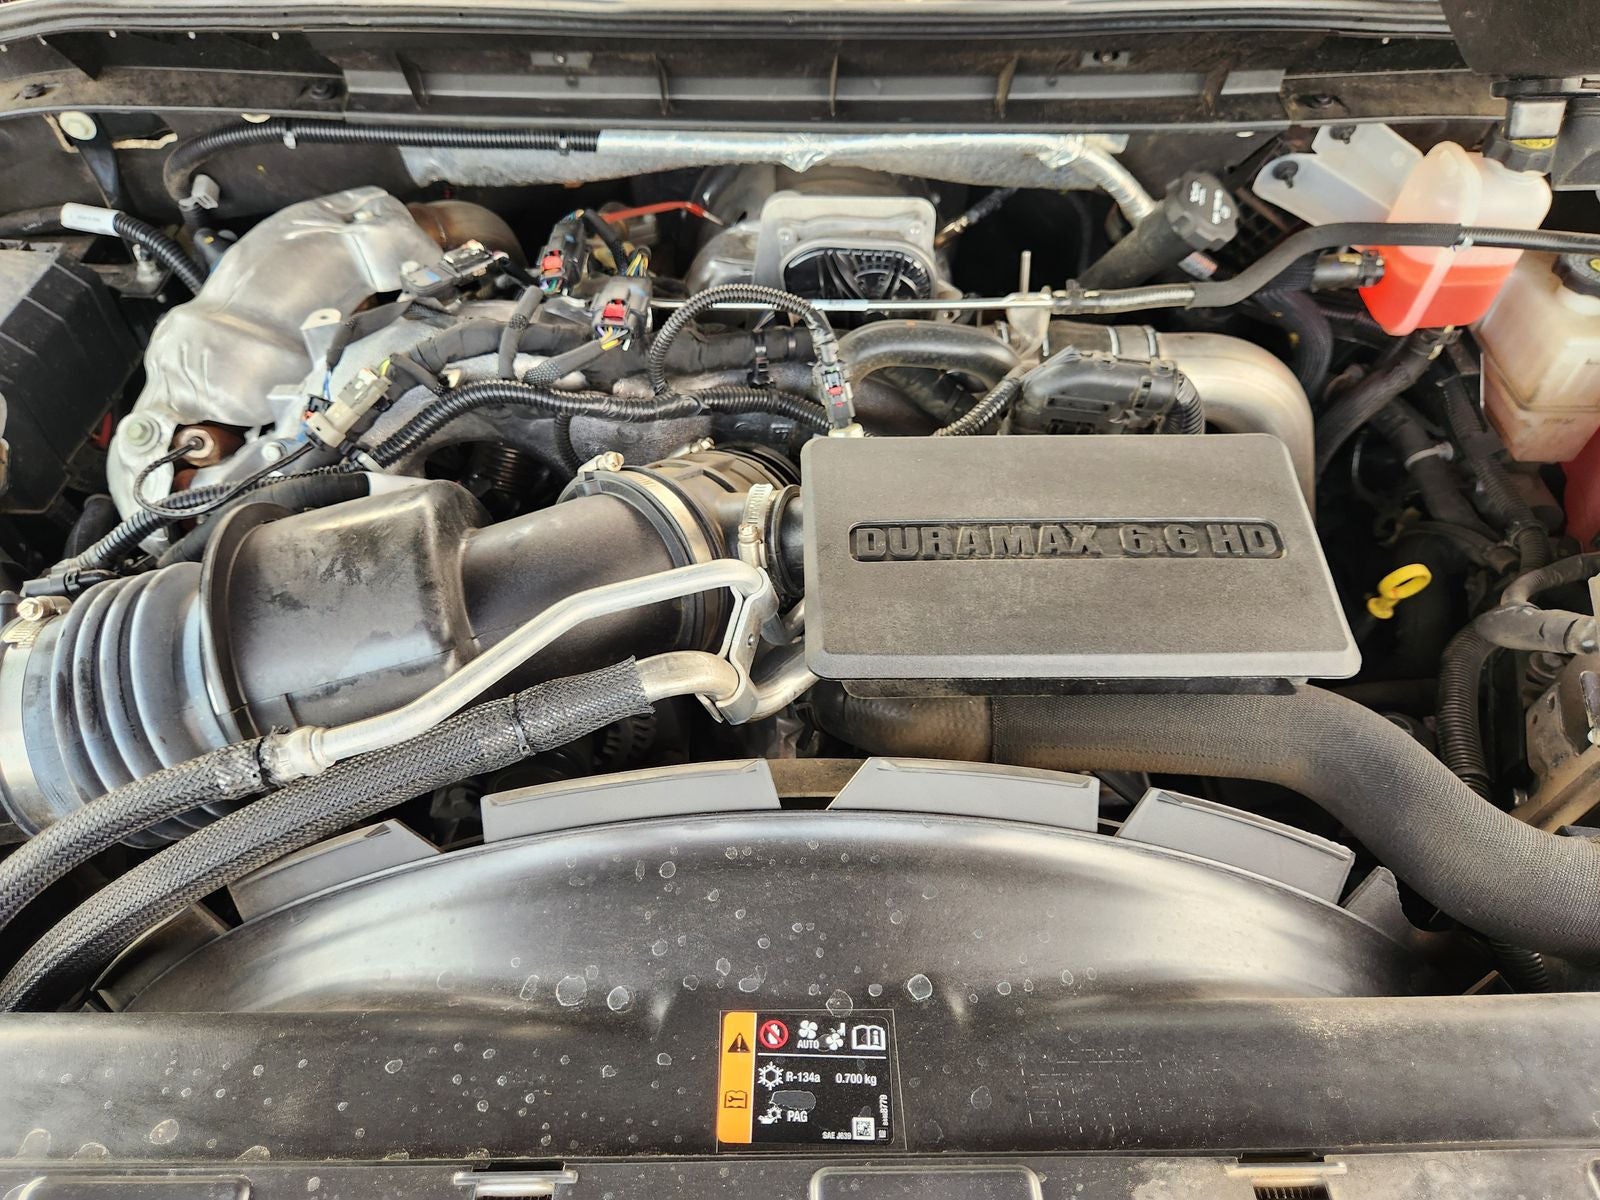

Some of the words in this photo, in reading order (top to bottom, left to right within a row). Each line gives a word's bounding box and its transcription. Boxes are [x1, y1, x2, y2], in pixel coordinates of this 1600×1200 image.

[856, 524, 1101, 557] DURAMAX
[1119, 524, 1199, 556] 6.6
[1206, 523, 1279, 556] HD
[797, 1039, 820, 1049] AUTO
[785, 1071, 821, 1083] R-134a
[835, 1073, 863, 1084] 0.700
[864, 1074, 877, 1086] kg
[786, 1111, 808, 1123] PAG
[822, 1131, 836, 1139] SAE
